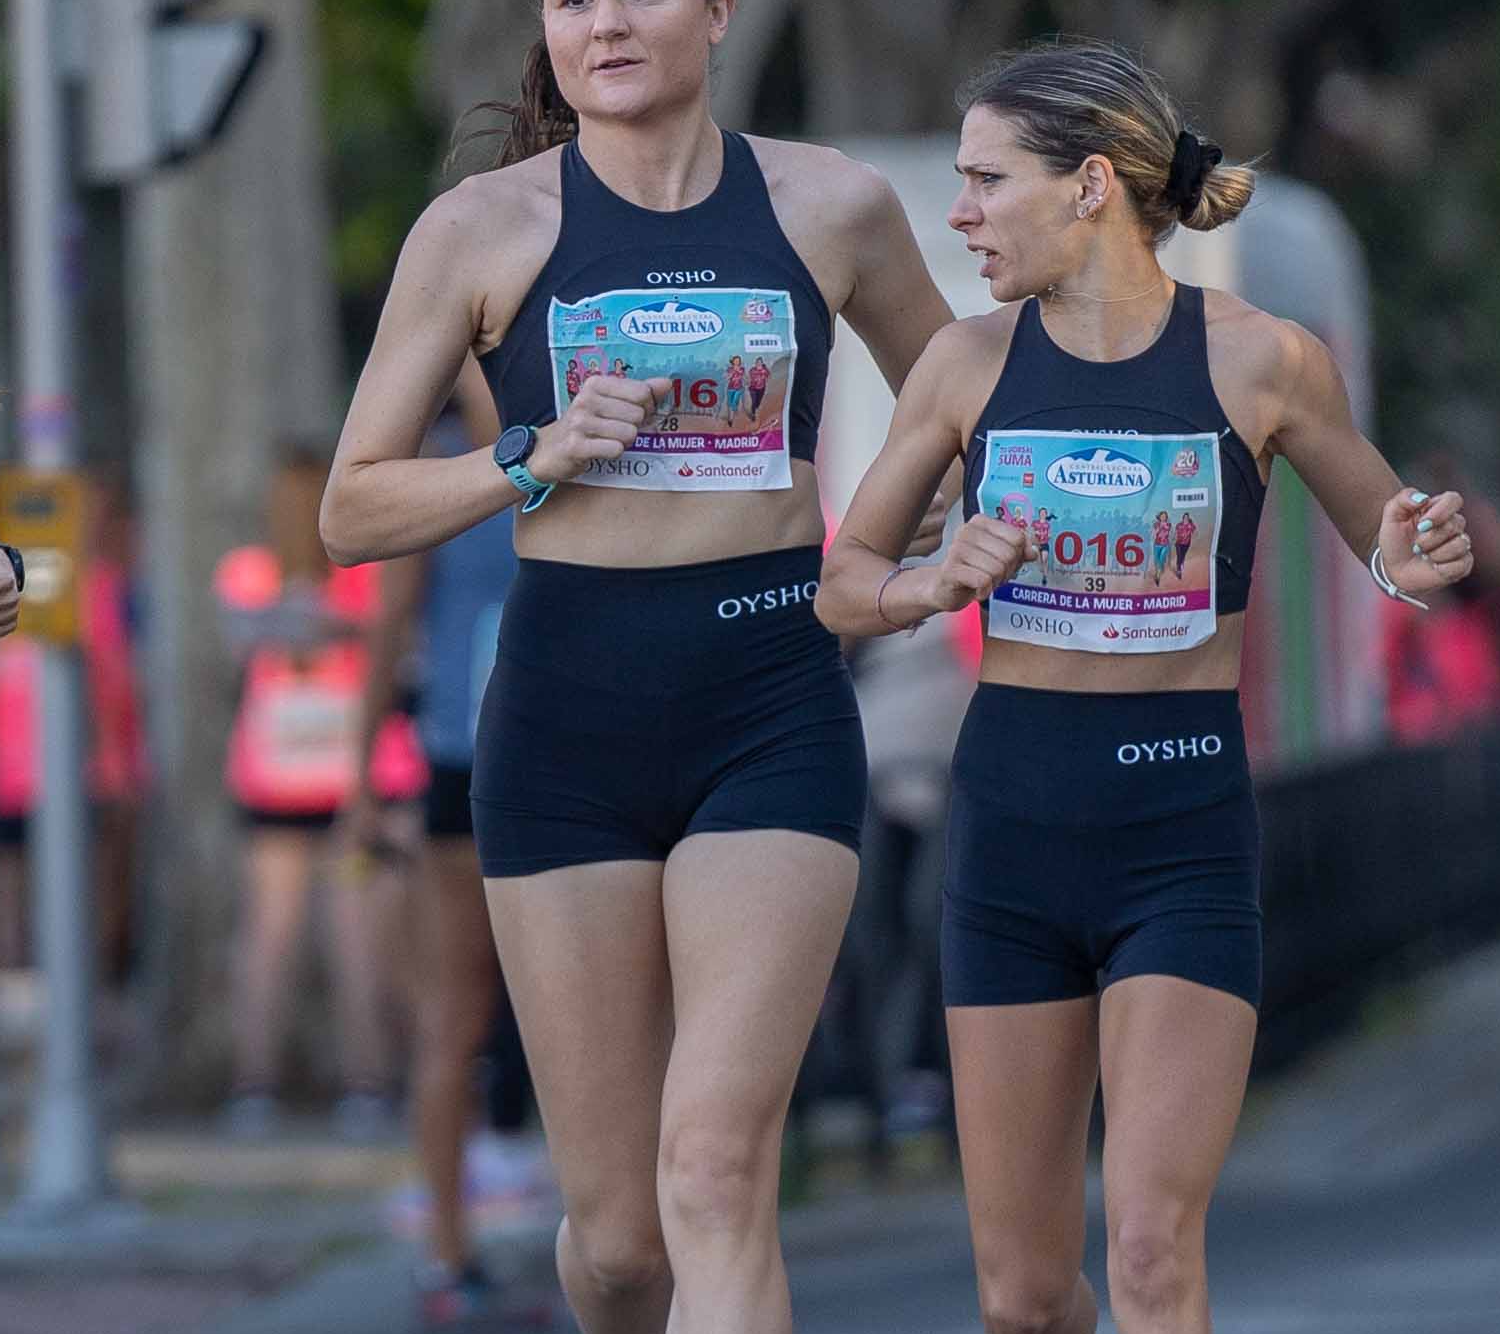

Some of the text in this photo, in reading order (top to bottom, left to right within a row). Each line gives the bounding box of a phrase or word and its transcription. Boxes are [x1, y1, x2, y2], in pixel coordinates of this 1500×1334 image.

[646, 269, 717, 284] OYSHO
[627, 316, 717, 334] ASTURIANA
[671, 378, 719, 408] 16
[635, 436, 760, 449] DE LA MUJER MADRID
[998, 453, 1032, 466] SUMA
[1177, 451, 1196, 467] 20
[696, 464, 766, 478] Santander
[1053, 467, 1146, 487] ASTURIANA
[1054, 531, 1146, 567] 016
[1084, 577, 1106, 592] 39
[717, 581, 820, 618] OYSHO
[1012, 587, 1186, 611] CARRERA DE LA MUJER MADRID
[1010, 612, 1190, 639] OYSHO Santander
[1117, 735, 1221, 764] OYSHO
